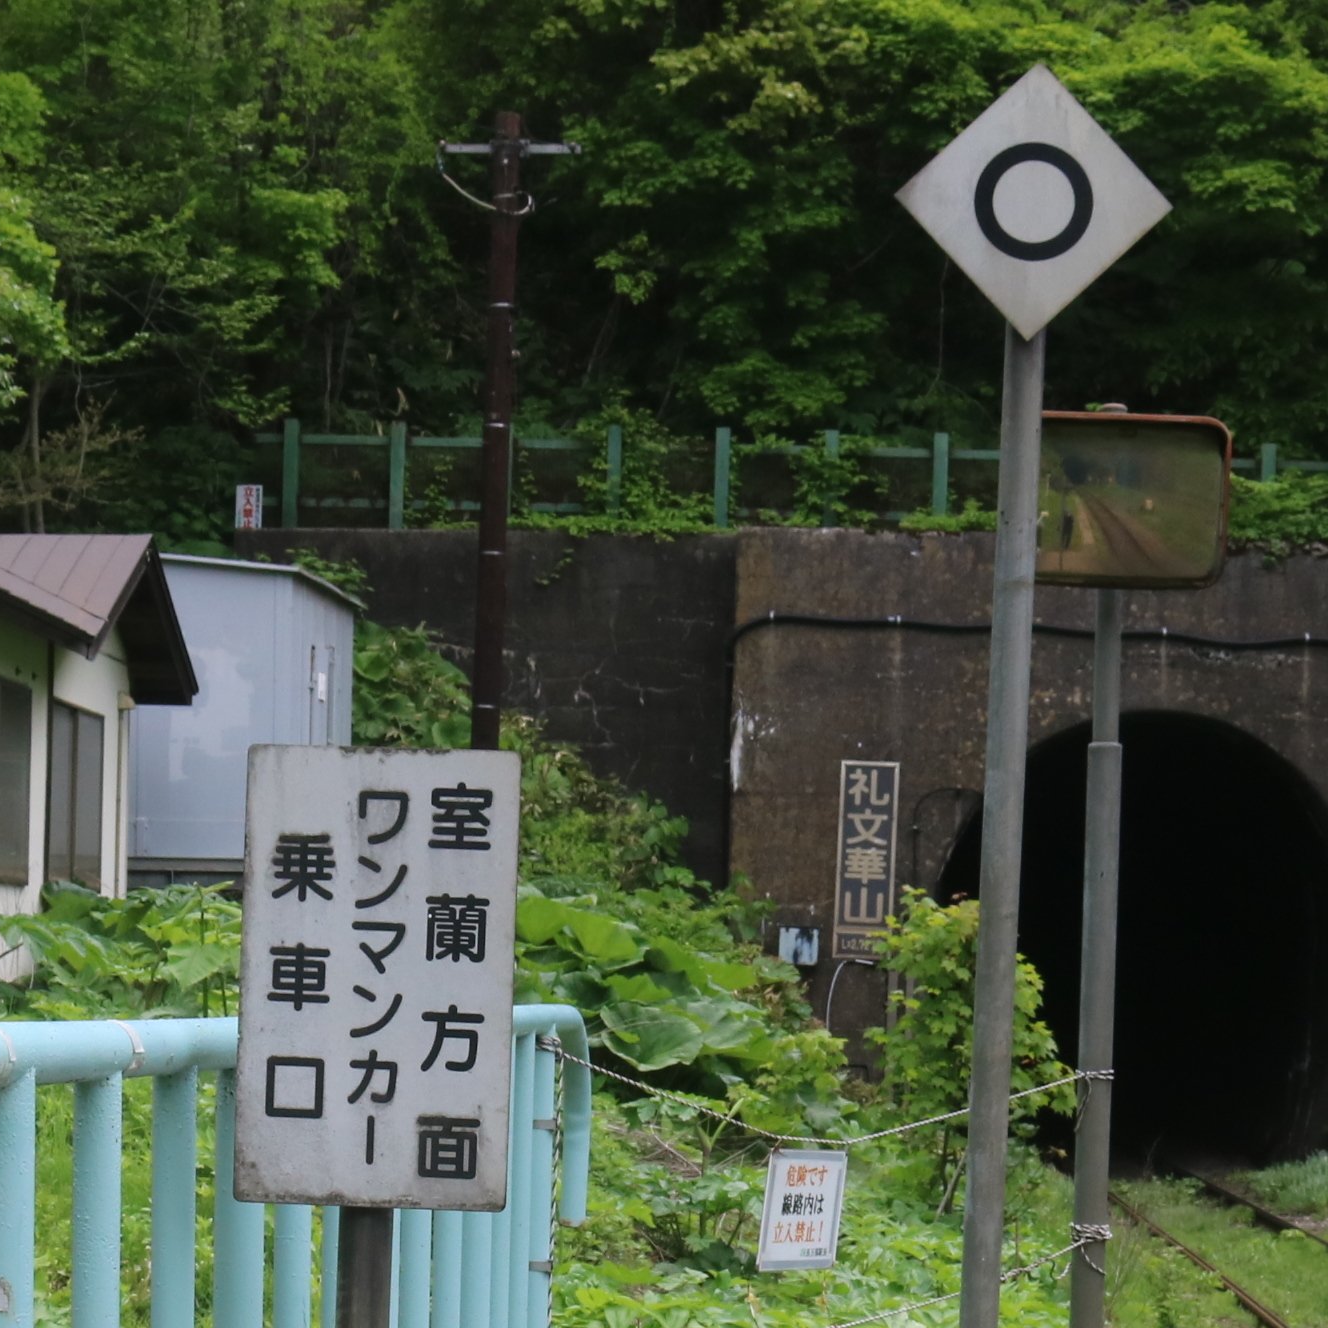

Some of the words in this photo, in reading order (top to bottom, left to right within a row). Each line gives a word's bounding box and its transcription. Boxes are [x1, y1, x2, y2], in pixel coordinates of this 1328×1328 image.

[843, 767, 890, 926] 礼文華山
[265, 833, 337, 1119] 乗車口
[348, 789, 410, 1166] ワンマンカー
[416, 782, 494, 1180] 室蘭方面
[780, 1193, 824, 1216] 線路内は
[785, 1164, 828, 1187] 危険です
